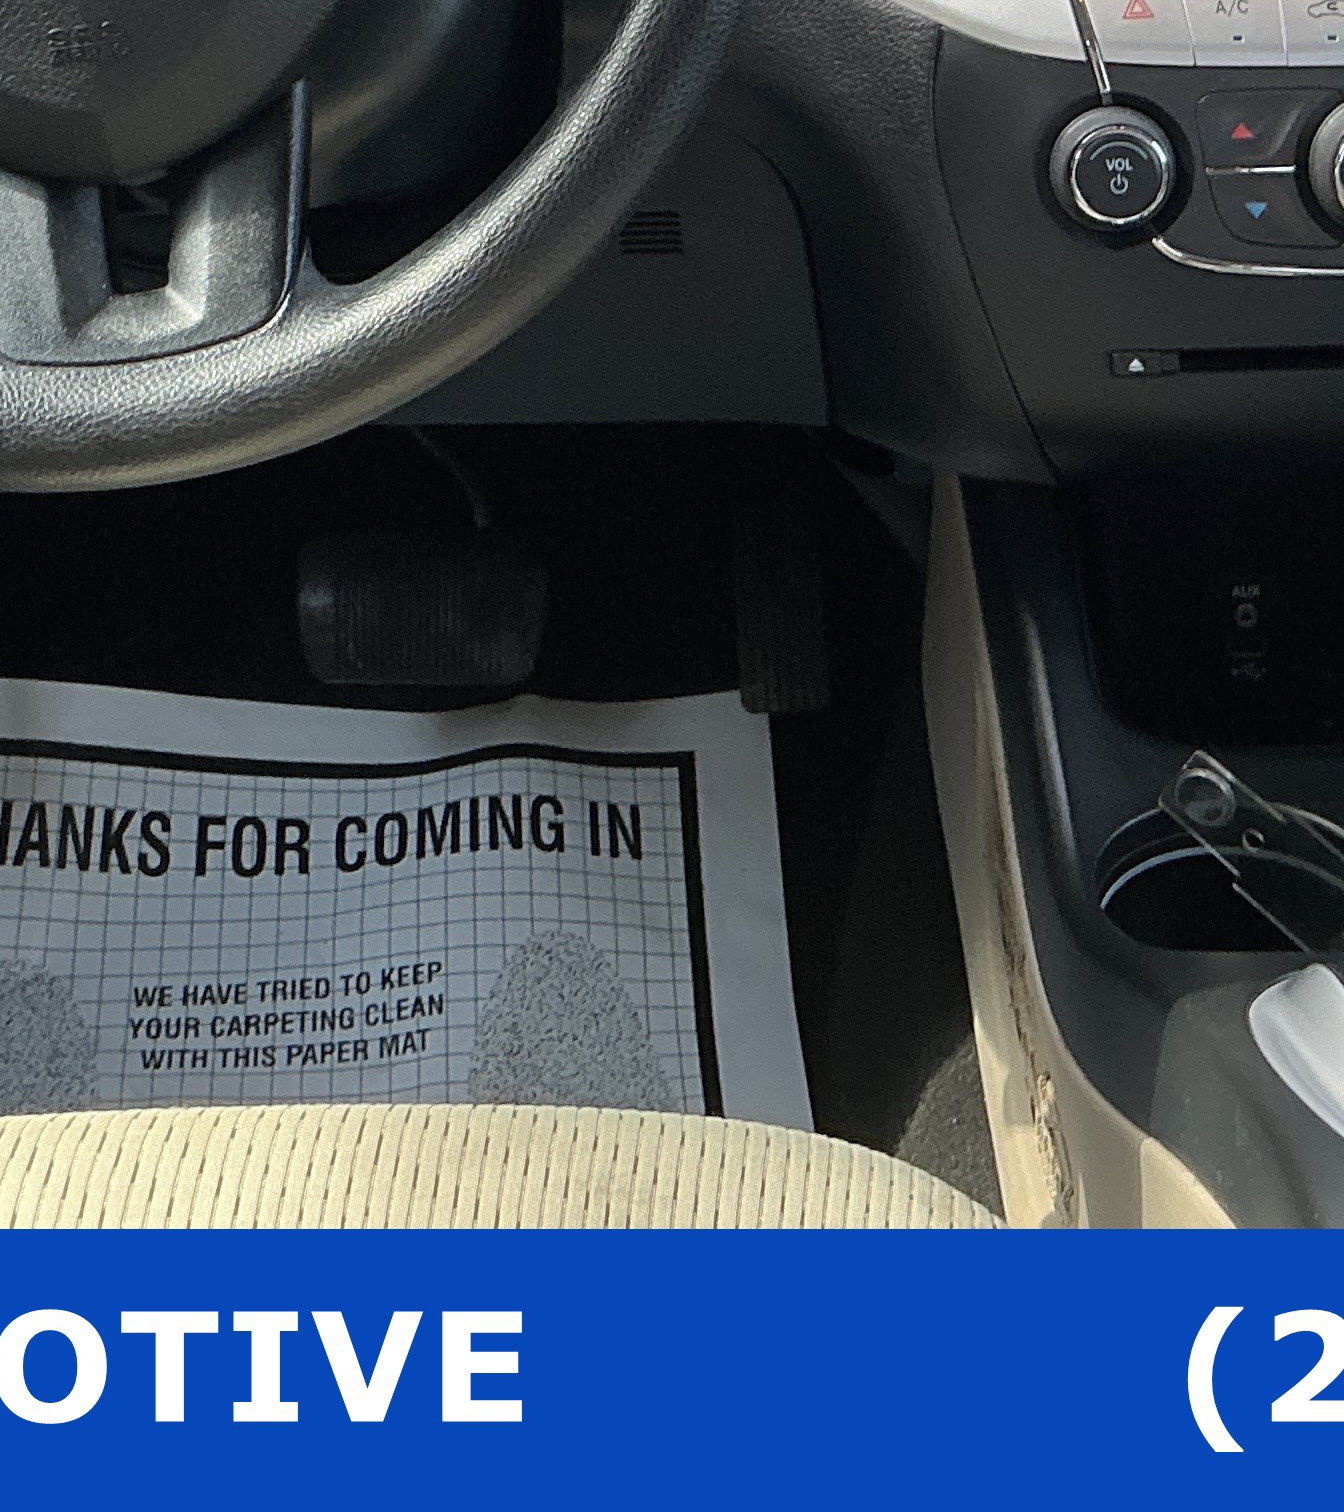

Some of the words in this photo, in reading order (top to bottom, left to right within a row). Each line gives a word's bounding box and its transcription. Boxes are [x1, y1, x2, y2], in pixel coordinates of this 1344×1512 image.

[1105, 157, 1135, 172] VOL
[194, 815, 311, 879] FOR
[335, 794, 565, 873] COMING
[590, 801, 643, 861] IN
[133, 986, 173, 1008] WE
[181, 982, 249, 1007] HAVE
[256, 976, 330, 1004] TRIED
[341, 972, 371, 997] TO
[381, 961, 443, 991] KEEP
[129, 1016, 201, 1040] YOUR
[210, 1007, 355, 1038] CARPETING
[365, 993, 444, 1028] CLEAN
[140, 1048, 207, 1071] WITH
[221, 1045, 277, 1069] THIS
[286, 1038, 369, 1068] PAPER
[379, 1028, 431, 1059] MAT
